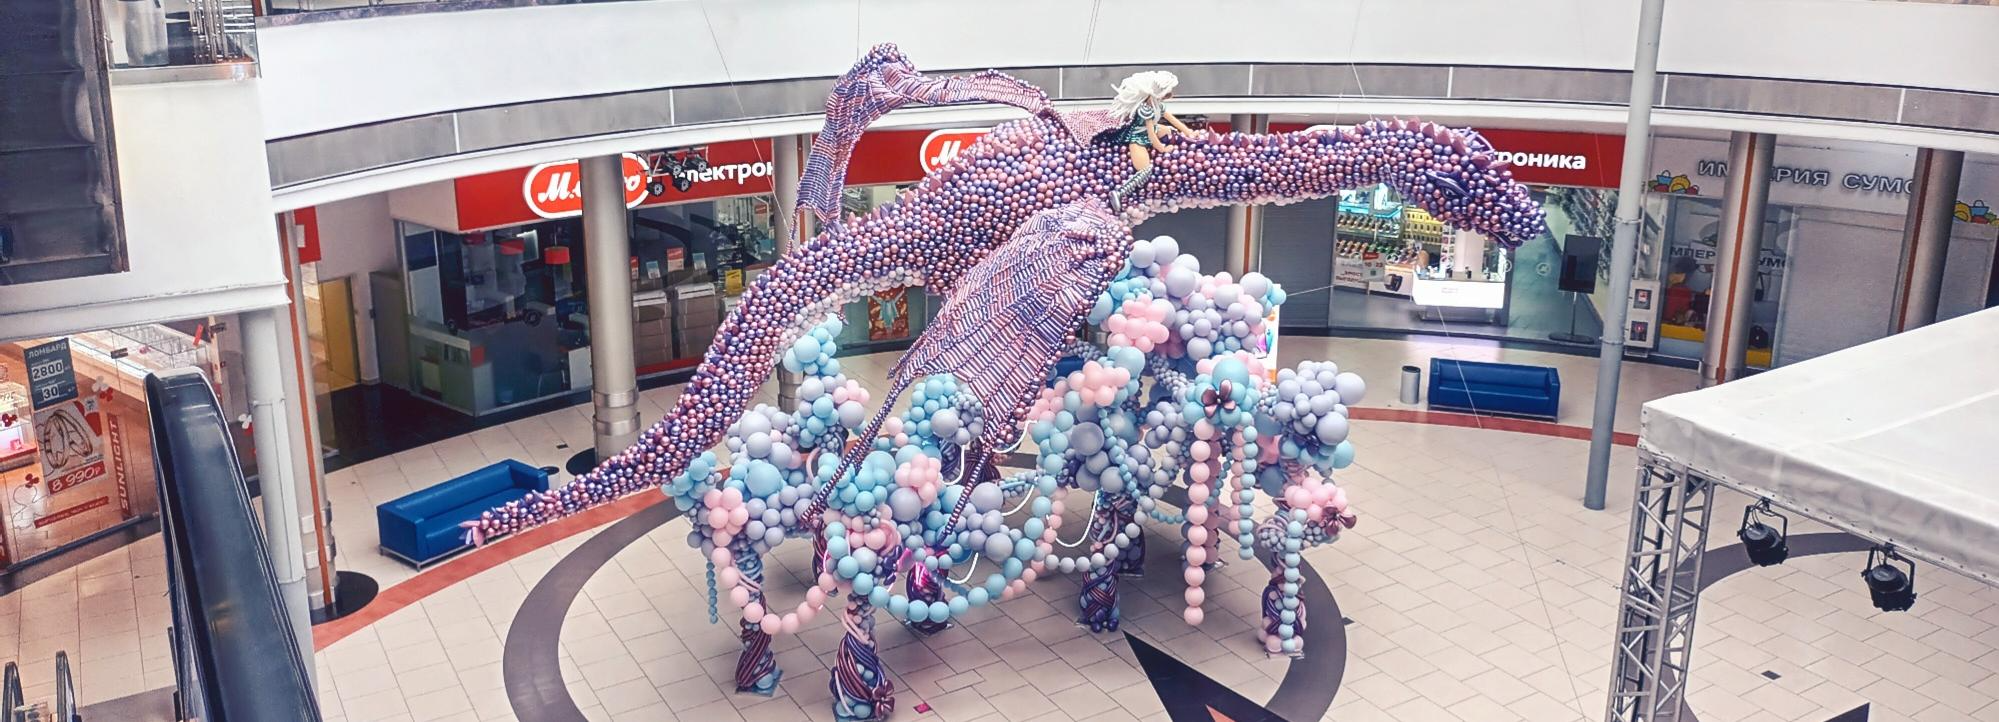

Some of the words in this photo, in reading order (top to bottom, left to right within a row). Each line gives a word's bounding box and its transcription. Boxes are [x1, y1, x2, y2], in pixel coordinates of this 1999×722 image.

[28, 342, 67, 358] ЛОМБАРД
[32, 362, 63, 380] 2800
[43, 386, 58, 399] 30
[110, 421, 129, 511] SUNLIGHT
